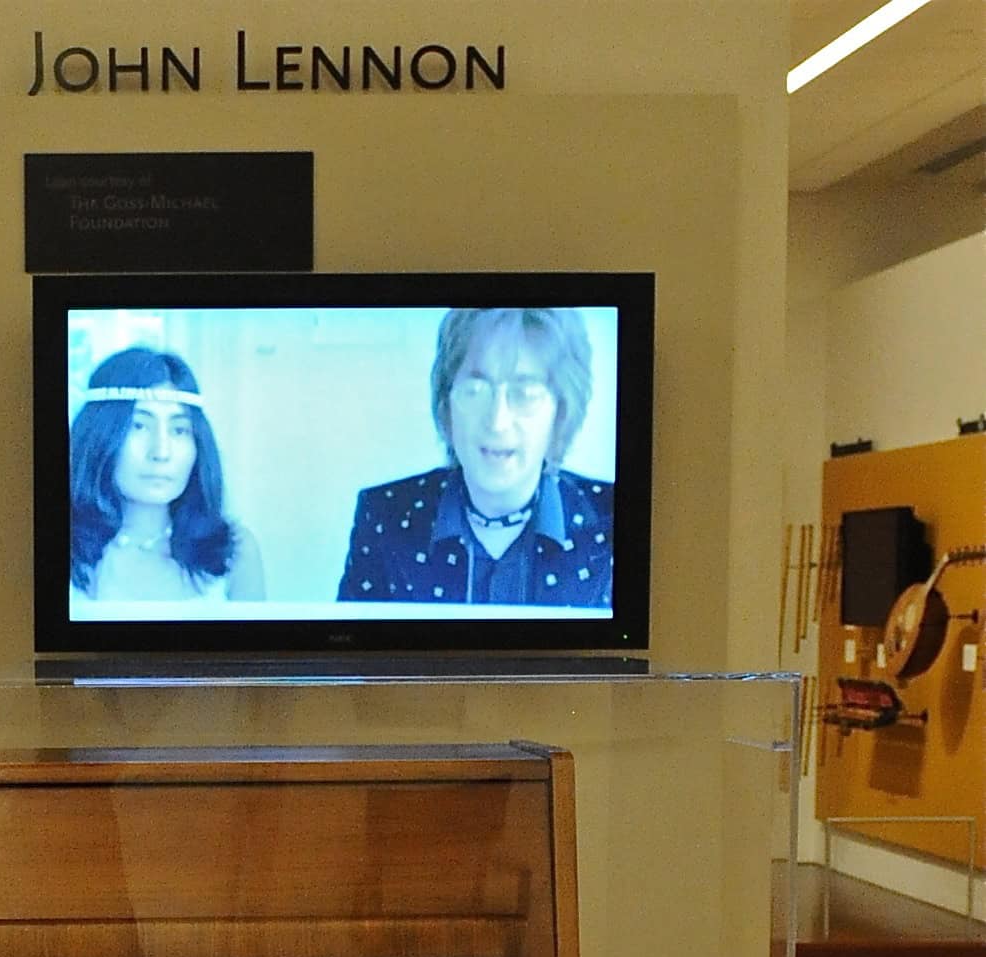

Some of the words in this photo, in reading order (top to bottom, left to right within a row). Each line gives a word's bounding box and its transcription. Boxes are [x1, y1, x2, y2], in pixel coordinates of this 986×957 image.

[28, 31, 201, 96] JOHN
[237, 30, 506, 92] LENNON
[69, 214, 170, 231] FOUNDATION
